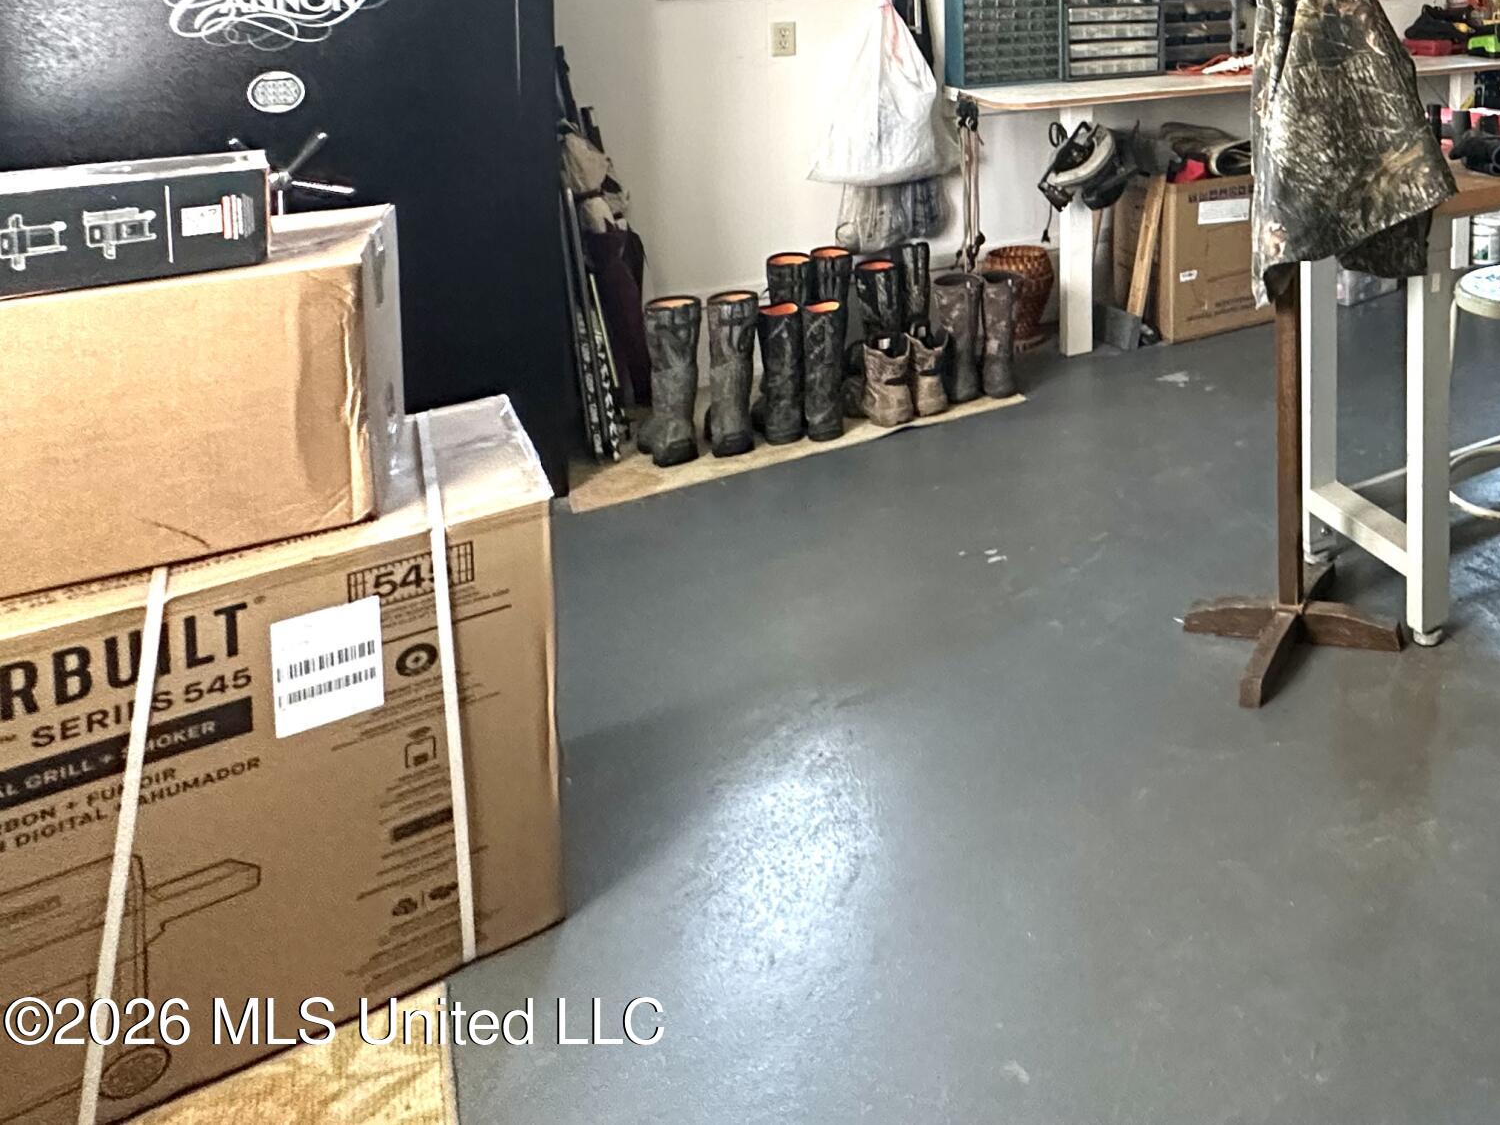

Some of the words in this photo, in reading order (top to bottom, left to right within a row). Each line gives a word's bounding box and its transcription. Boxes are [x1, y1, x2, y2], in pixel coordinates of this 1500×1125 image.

[184, 666, 252, 704] 545
[24, 760, 96, 790] GRILL
[14, 808, 108, 847] DIGITAL
